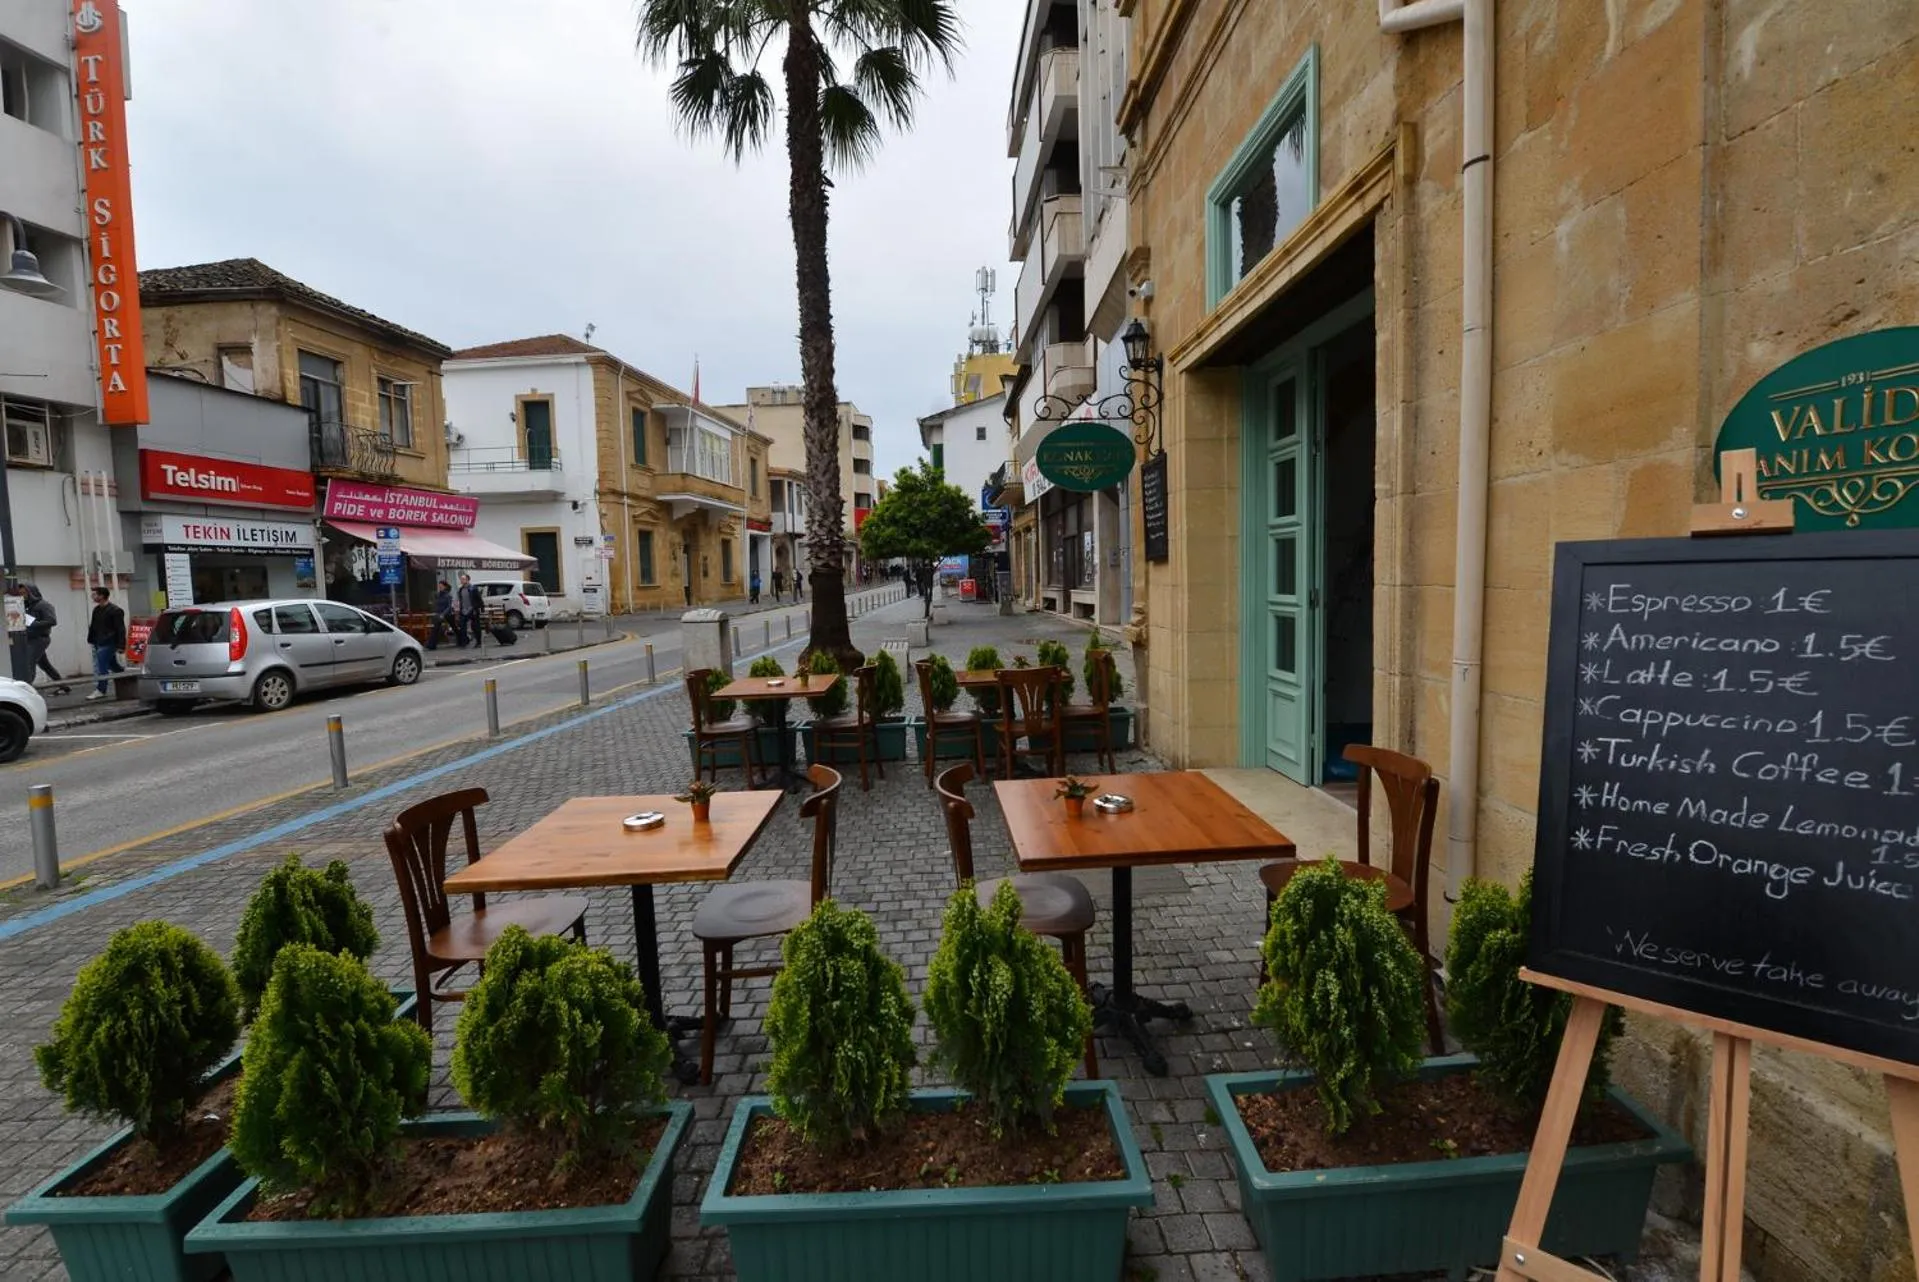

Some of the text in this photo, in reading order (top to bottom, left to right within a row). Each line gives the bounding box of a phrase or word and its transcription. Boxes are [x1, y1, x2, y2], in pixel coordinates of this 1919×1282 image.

[81, 54, 128, 393] TÜRK SİGORTA
[1756, 443, 1848, 477] ANIM
[160, 463, 238, 492] Telsim
[333, 499, 366, 517] PİDE
[369, 508, 385, 519] ve
[431, 513, 473, 527] SALONU
[383, 489, 440, 509] İSTANBUL
[182, 523, 231, 541] TEKİN
[236, 523, 298, 546] İLETİŞİM
[437, 557, 477, 569] İSTANBUL
[1608, 584, 1752, 621] Espresso
[1603, 623, 1780, 653] Americano
[1602, 658, 1693, 687] Latte
[1594, 694, 1798, 738] Cappuccino
[1597, 737, 1717, 773] Turkish
[1732, 751, 1872, 788] Coffee
[1601, 781, 1670, 815] Home
[1677, 796, 1770, 829] Made
[1596, 824, 1682, 864] Fresh
[1689, 839, 1816, 899] Orange
[1752, 951, 1825, 989] take
[1837, 977, 1919, 1021] away
